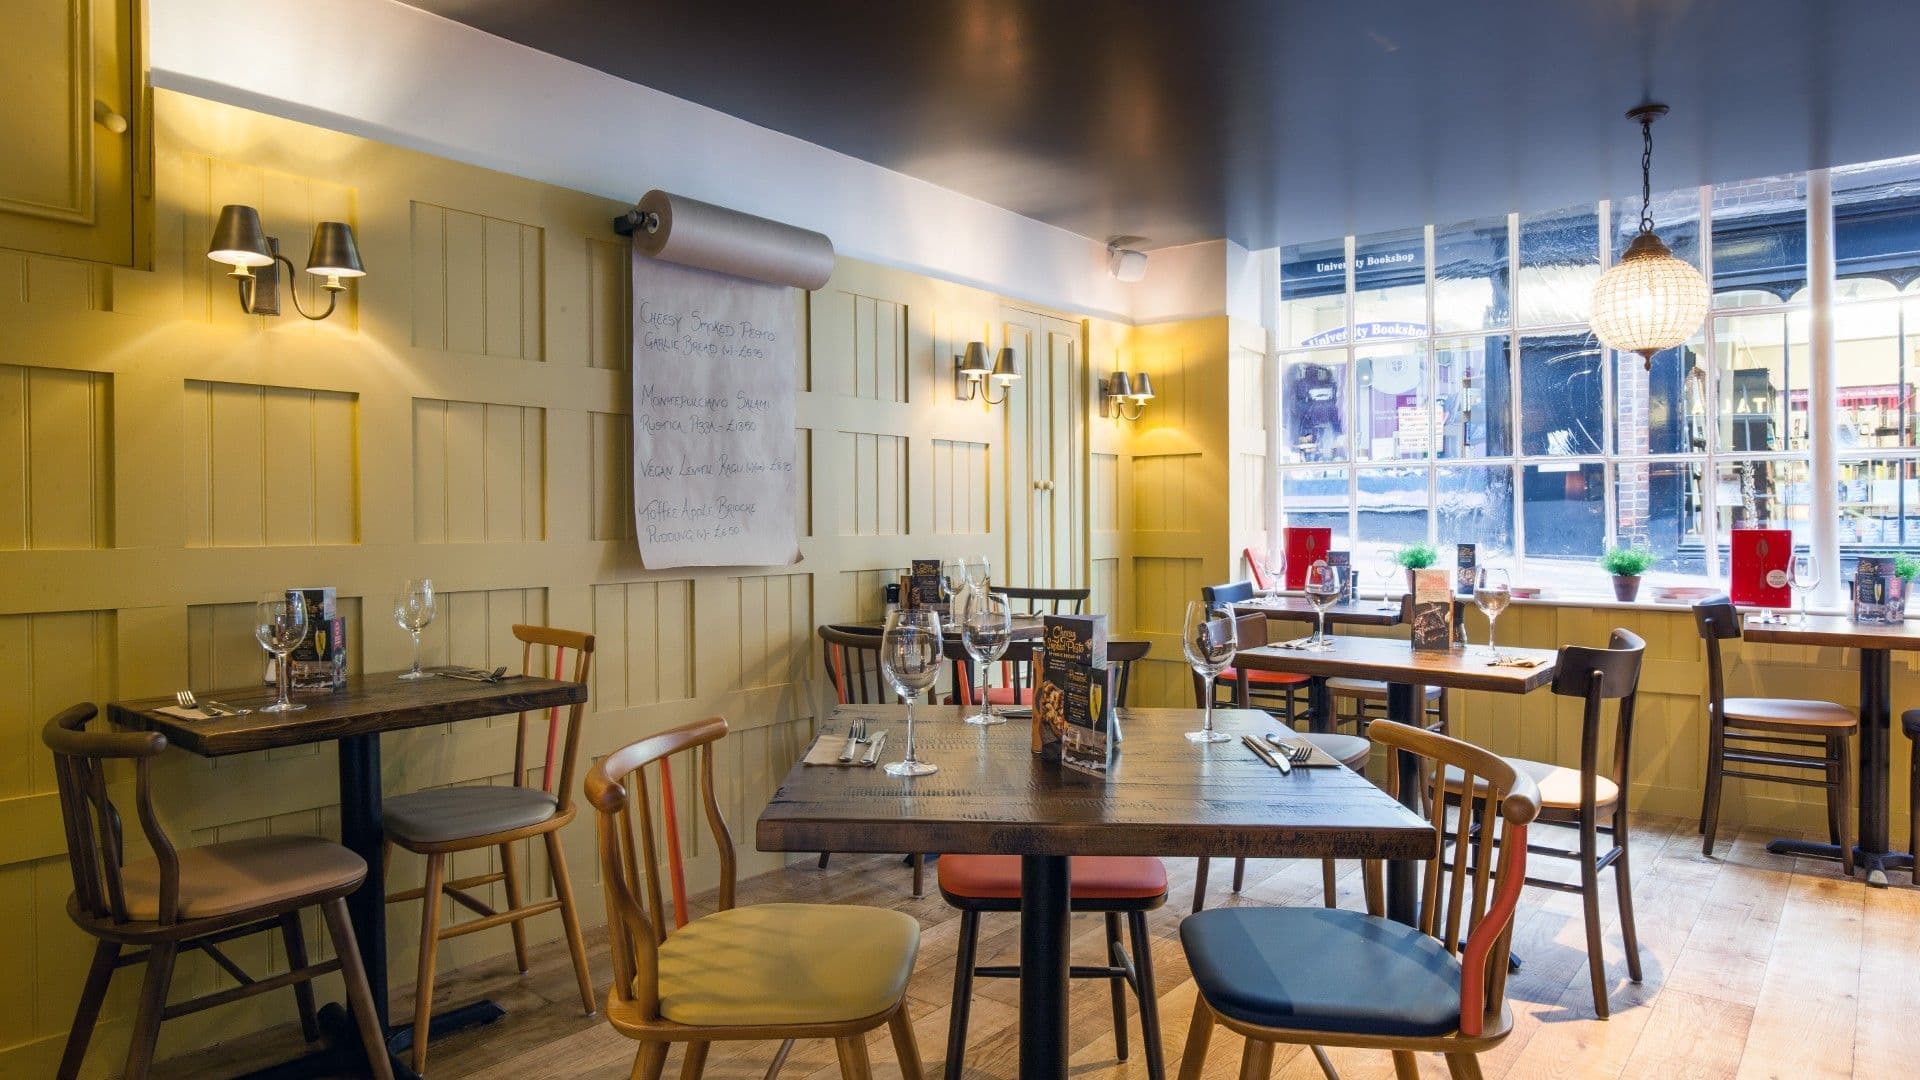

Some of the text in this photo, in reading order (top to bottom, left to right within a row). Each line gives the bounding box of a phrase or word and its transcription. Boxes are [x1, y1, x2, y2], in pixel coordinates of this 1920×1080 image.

[1316, 252, 1415, 273] Univerty Bookshop
[1308, 326, 1369, 346] Univerty
